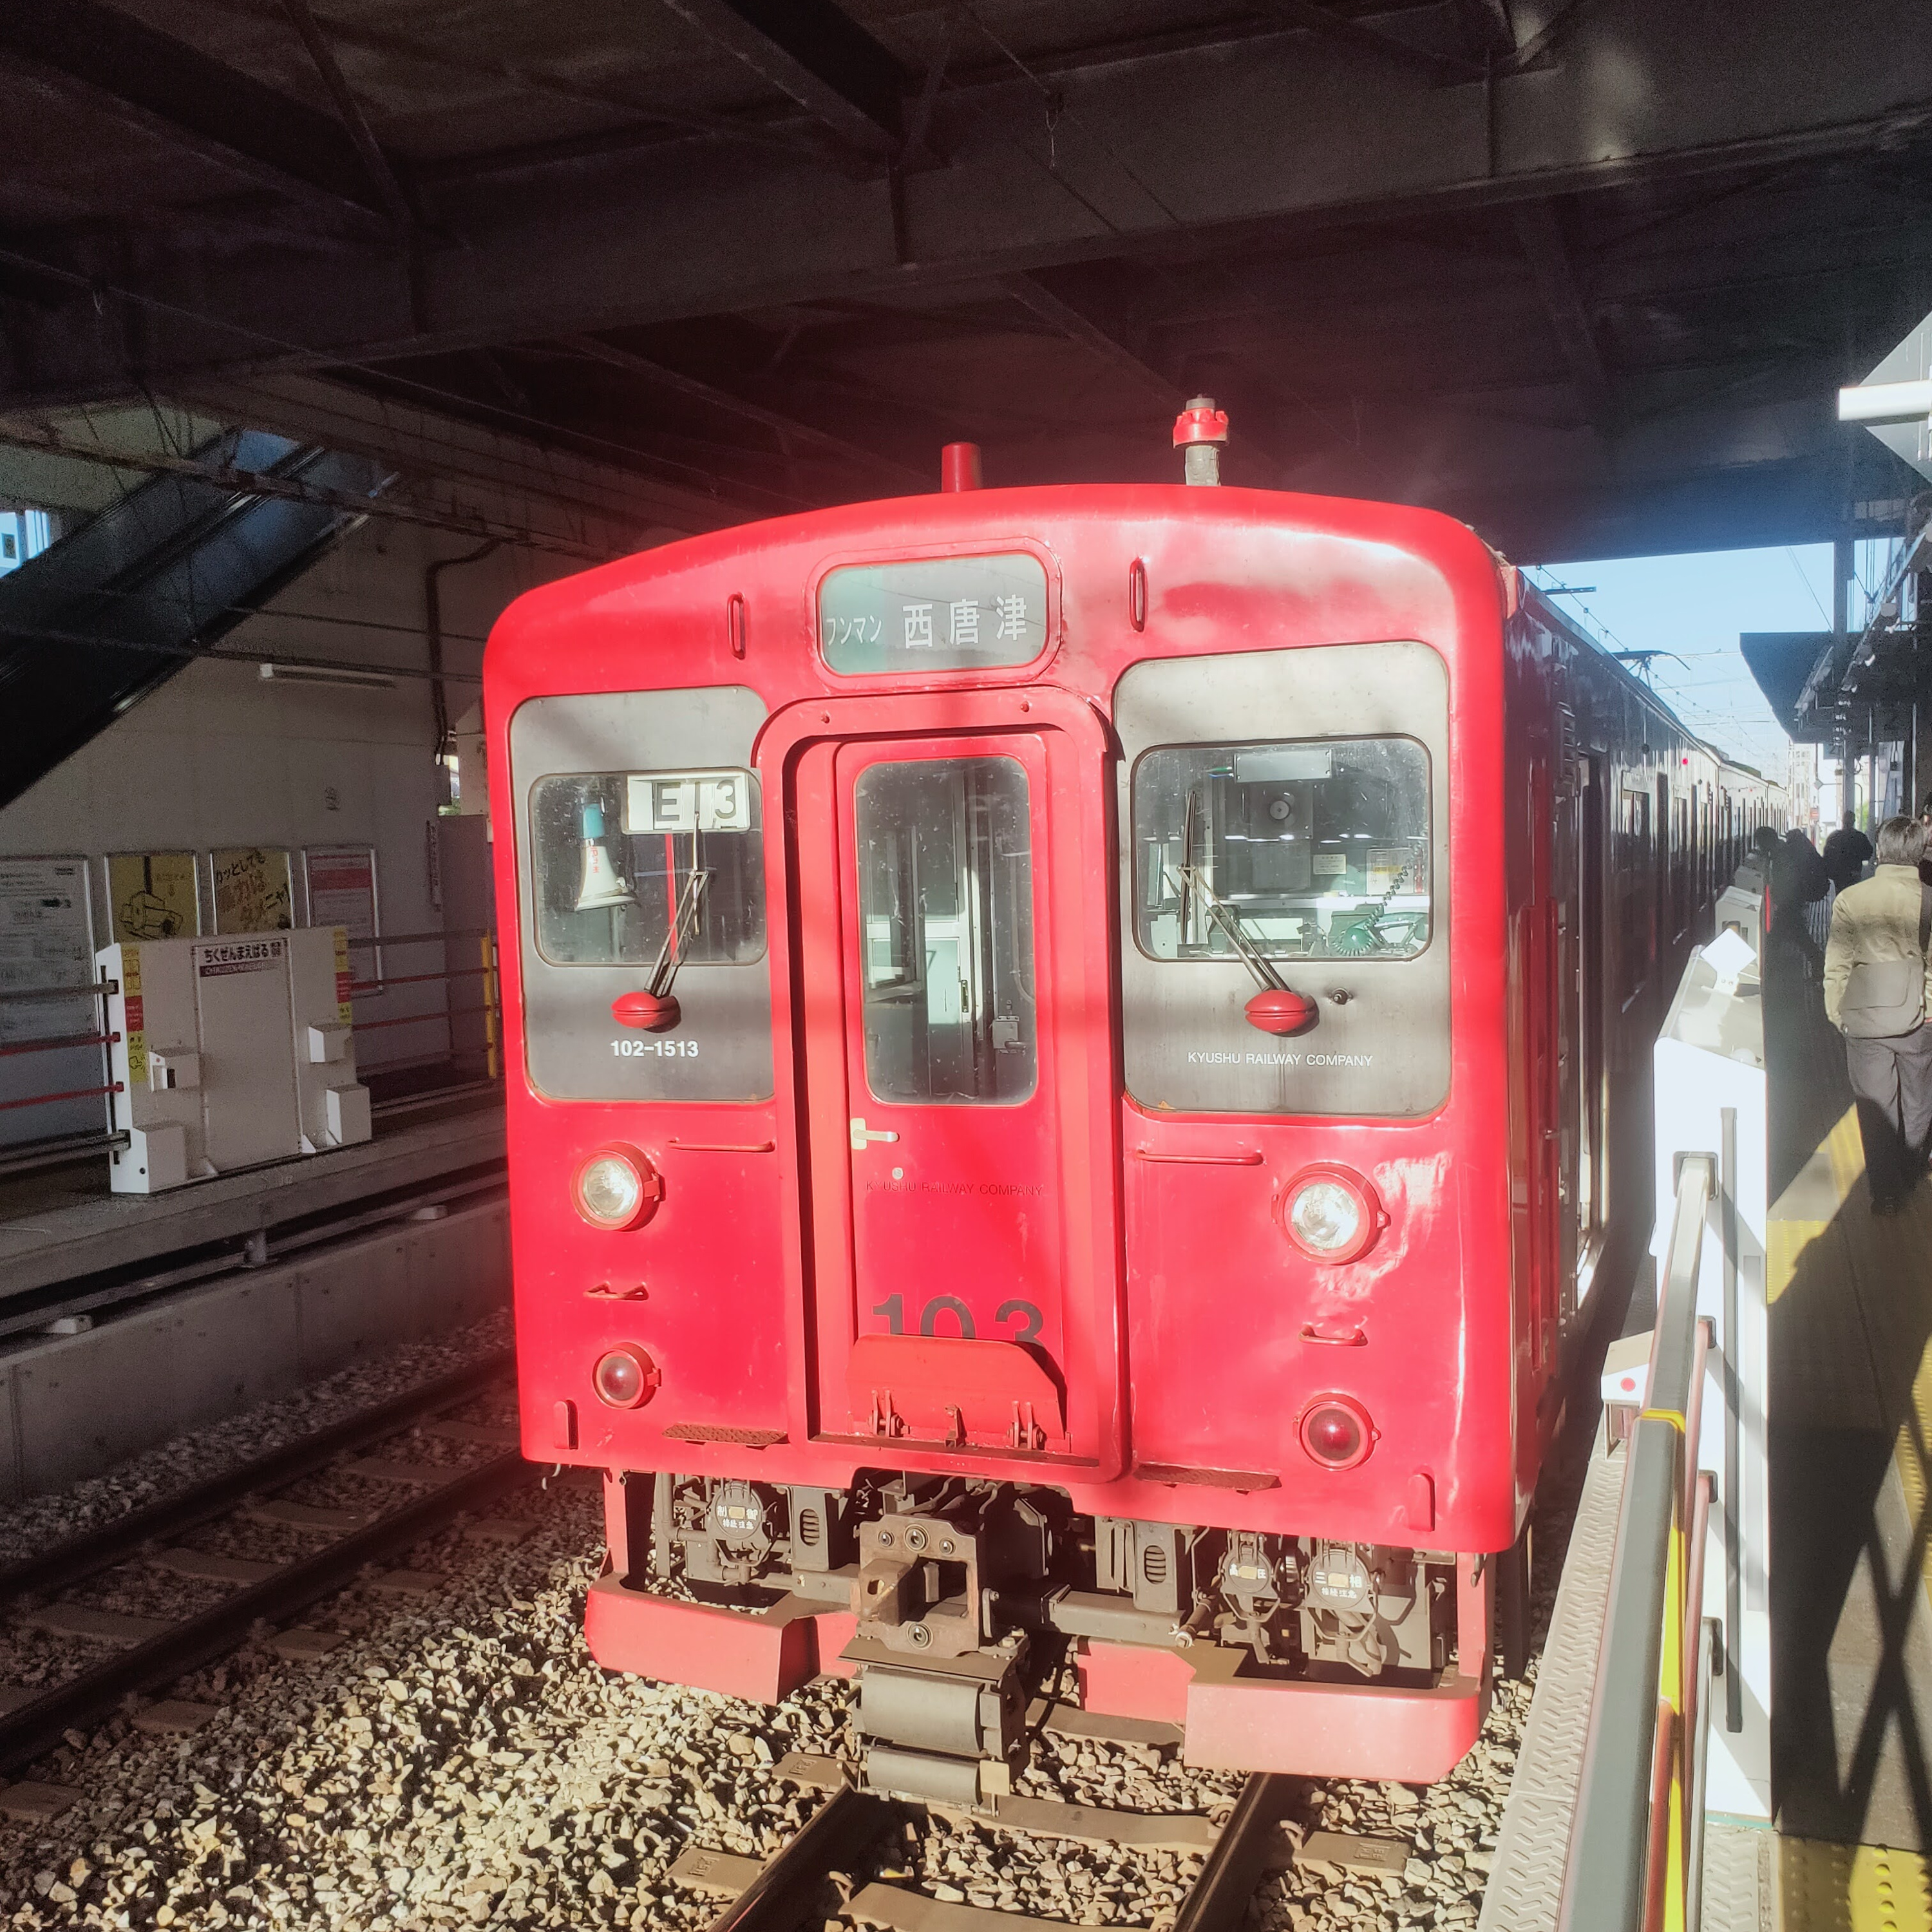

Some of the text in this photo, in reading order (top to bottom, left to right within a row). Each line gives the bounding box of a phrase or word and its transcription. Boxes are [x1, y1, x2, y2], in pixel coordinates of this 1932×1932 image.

[902, 594, 1027, 649] 西唐津
[656, 779, 735, 822] E13
[204, 942, 269, 963] ちくぜんまえばる
[611, 1039, 699, 1057] 102-1513
[1188, 1051, 1374, 1067] KYUSHU RAILWAY COMPANY
[866, 1180, 1043, 1197] KYUSHU RAILWAY COMPANY
[716, 1504, 759, 1520] 制御
[1314, 1571, 1362, 1588] 三相
